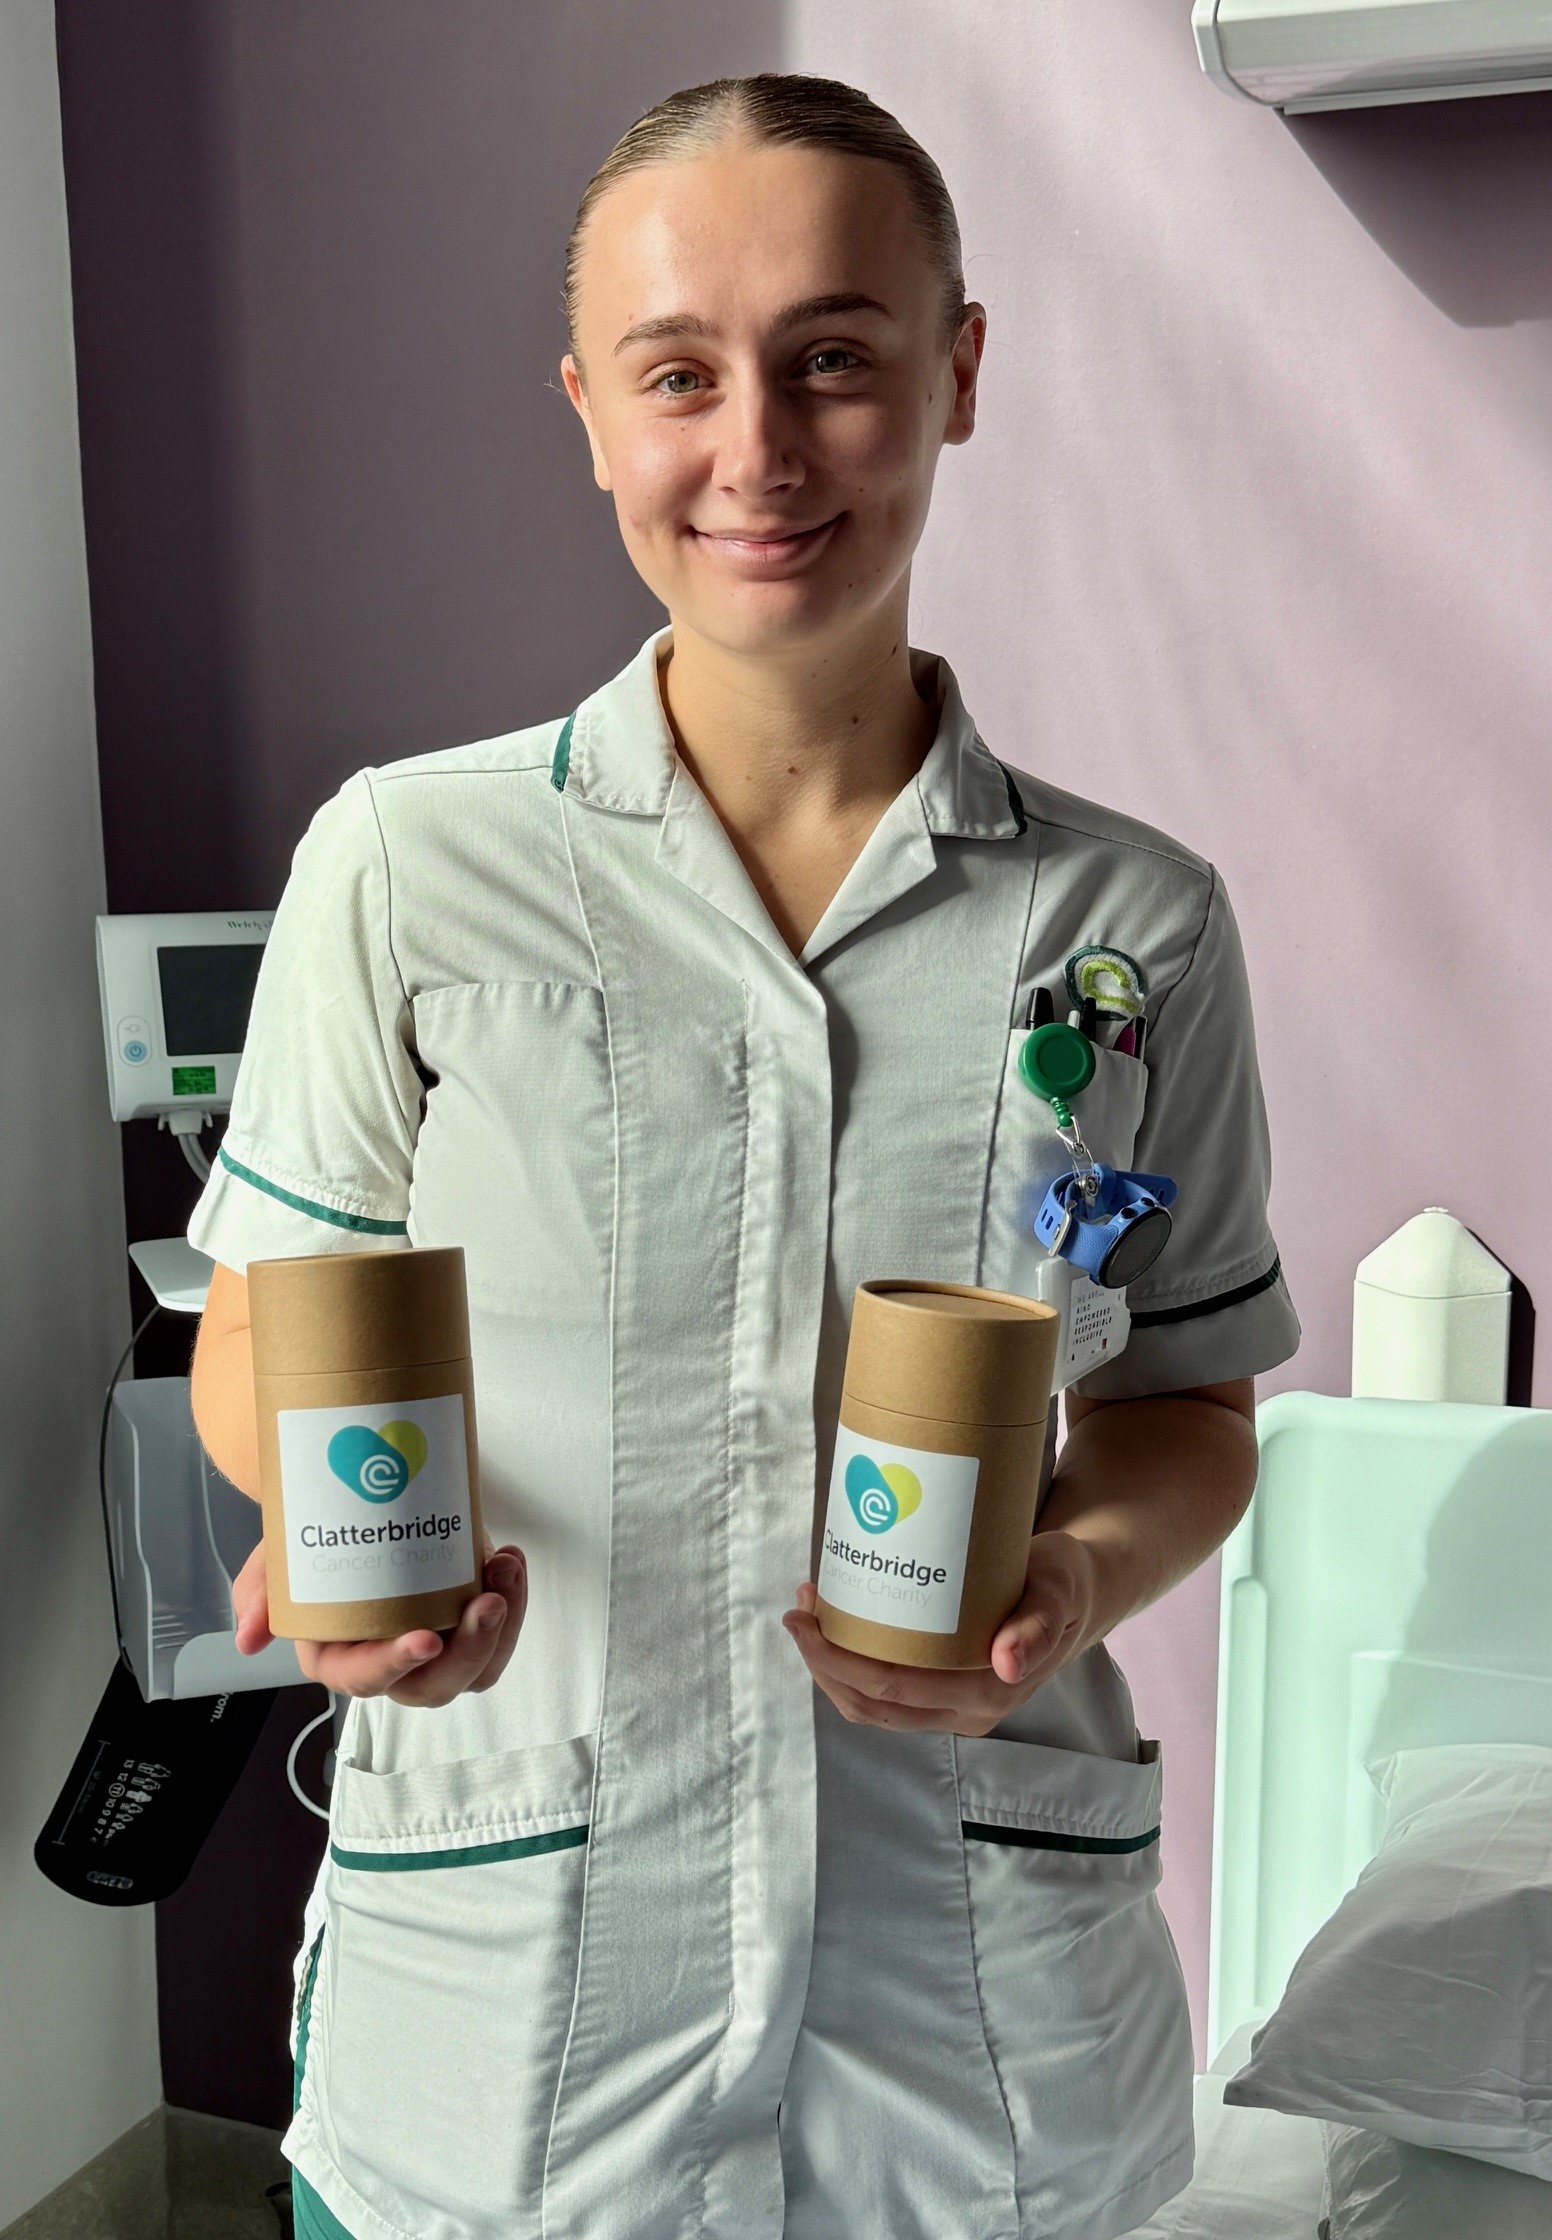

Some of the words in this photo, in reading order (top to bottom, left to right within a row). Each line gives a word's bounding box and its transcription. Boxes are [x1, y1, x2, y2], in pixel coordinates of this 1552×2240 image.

[1075, 1307, 1111, 1326] EMPOWERED
[1077, 1304, 1091, 1315] KIND
[1074, 1316, 1112, 1335] RESPONSIBLE
[1072, 1329, 1103, 1347] INCLUSIVE
[301, 1514, 462, 1548] Clatterbridge
[312, 1553, 384, 1573] Cancer
[390, 1545, 455, 1567] Charity
[825, 1528, 947, 1587] Clatterbridge
[867, 1577, 933, 1609] Charity
[123, 1759, 135, 1769] 13
[117, 1772, 129, 1782] 12
[105, 1798, 117, 1808] 10
[102, 1808, 112, 1817] 9
[97, 1817, 108, 1826] 8
[94, 1827, 104, 1835] 7
